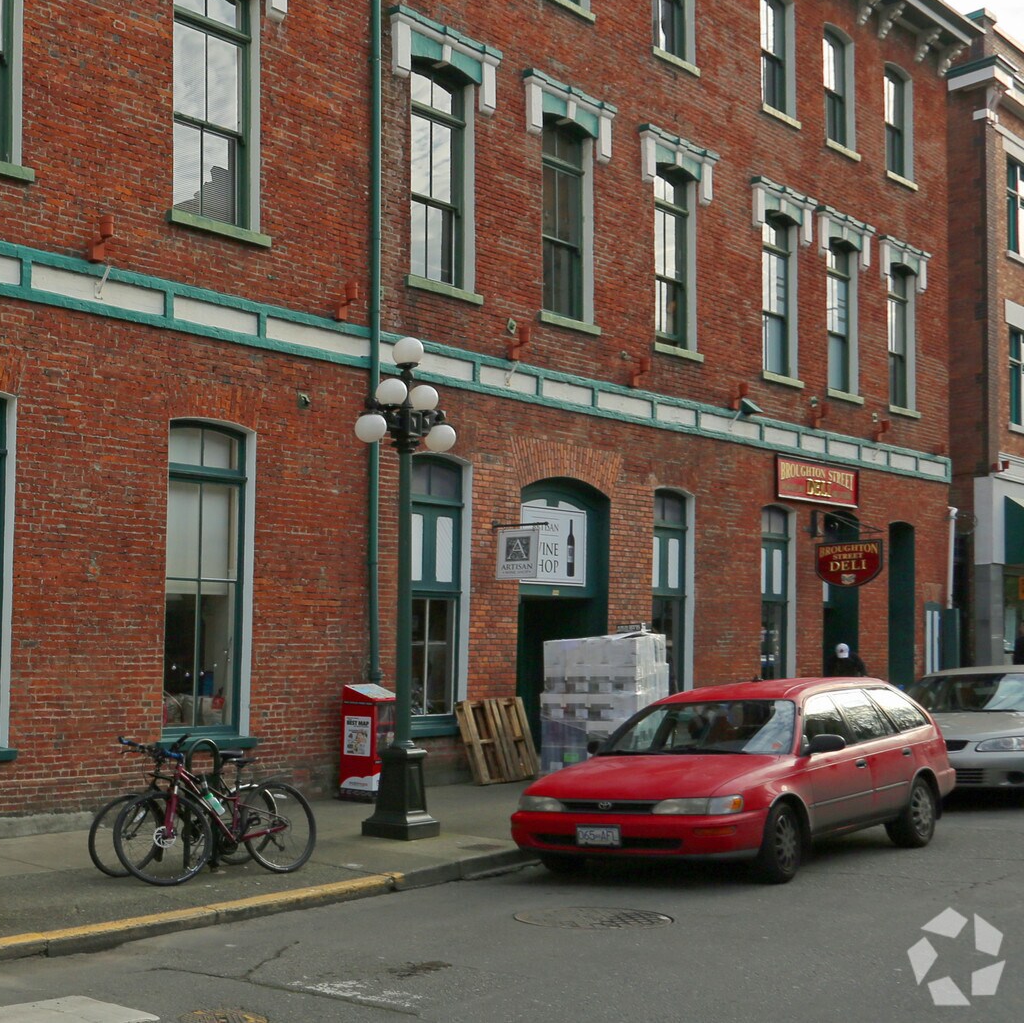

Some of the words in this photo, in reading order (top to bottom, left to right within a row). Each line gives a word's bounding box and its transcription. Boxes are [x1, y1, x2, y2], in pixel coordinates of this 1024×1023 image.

[780, 462, 826, 480] BROUGHTON
[828, 470, 854, 491] STREET
[806, 478, 832, 498] DELI
[539, 542, 558, 556] INE
[819, 543, 879, 558] BROUGHTON
[832, 552, 863, 560] STREET
[829, 559, 867, 572] DELI
